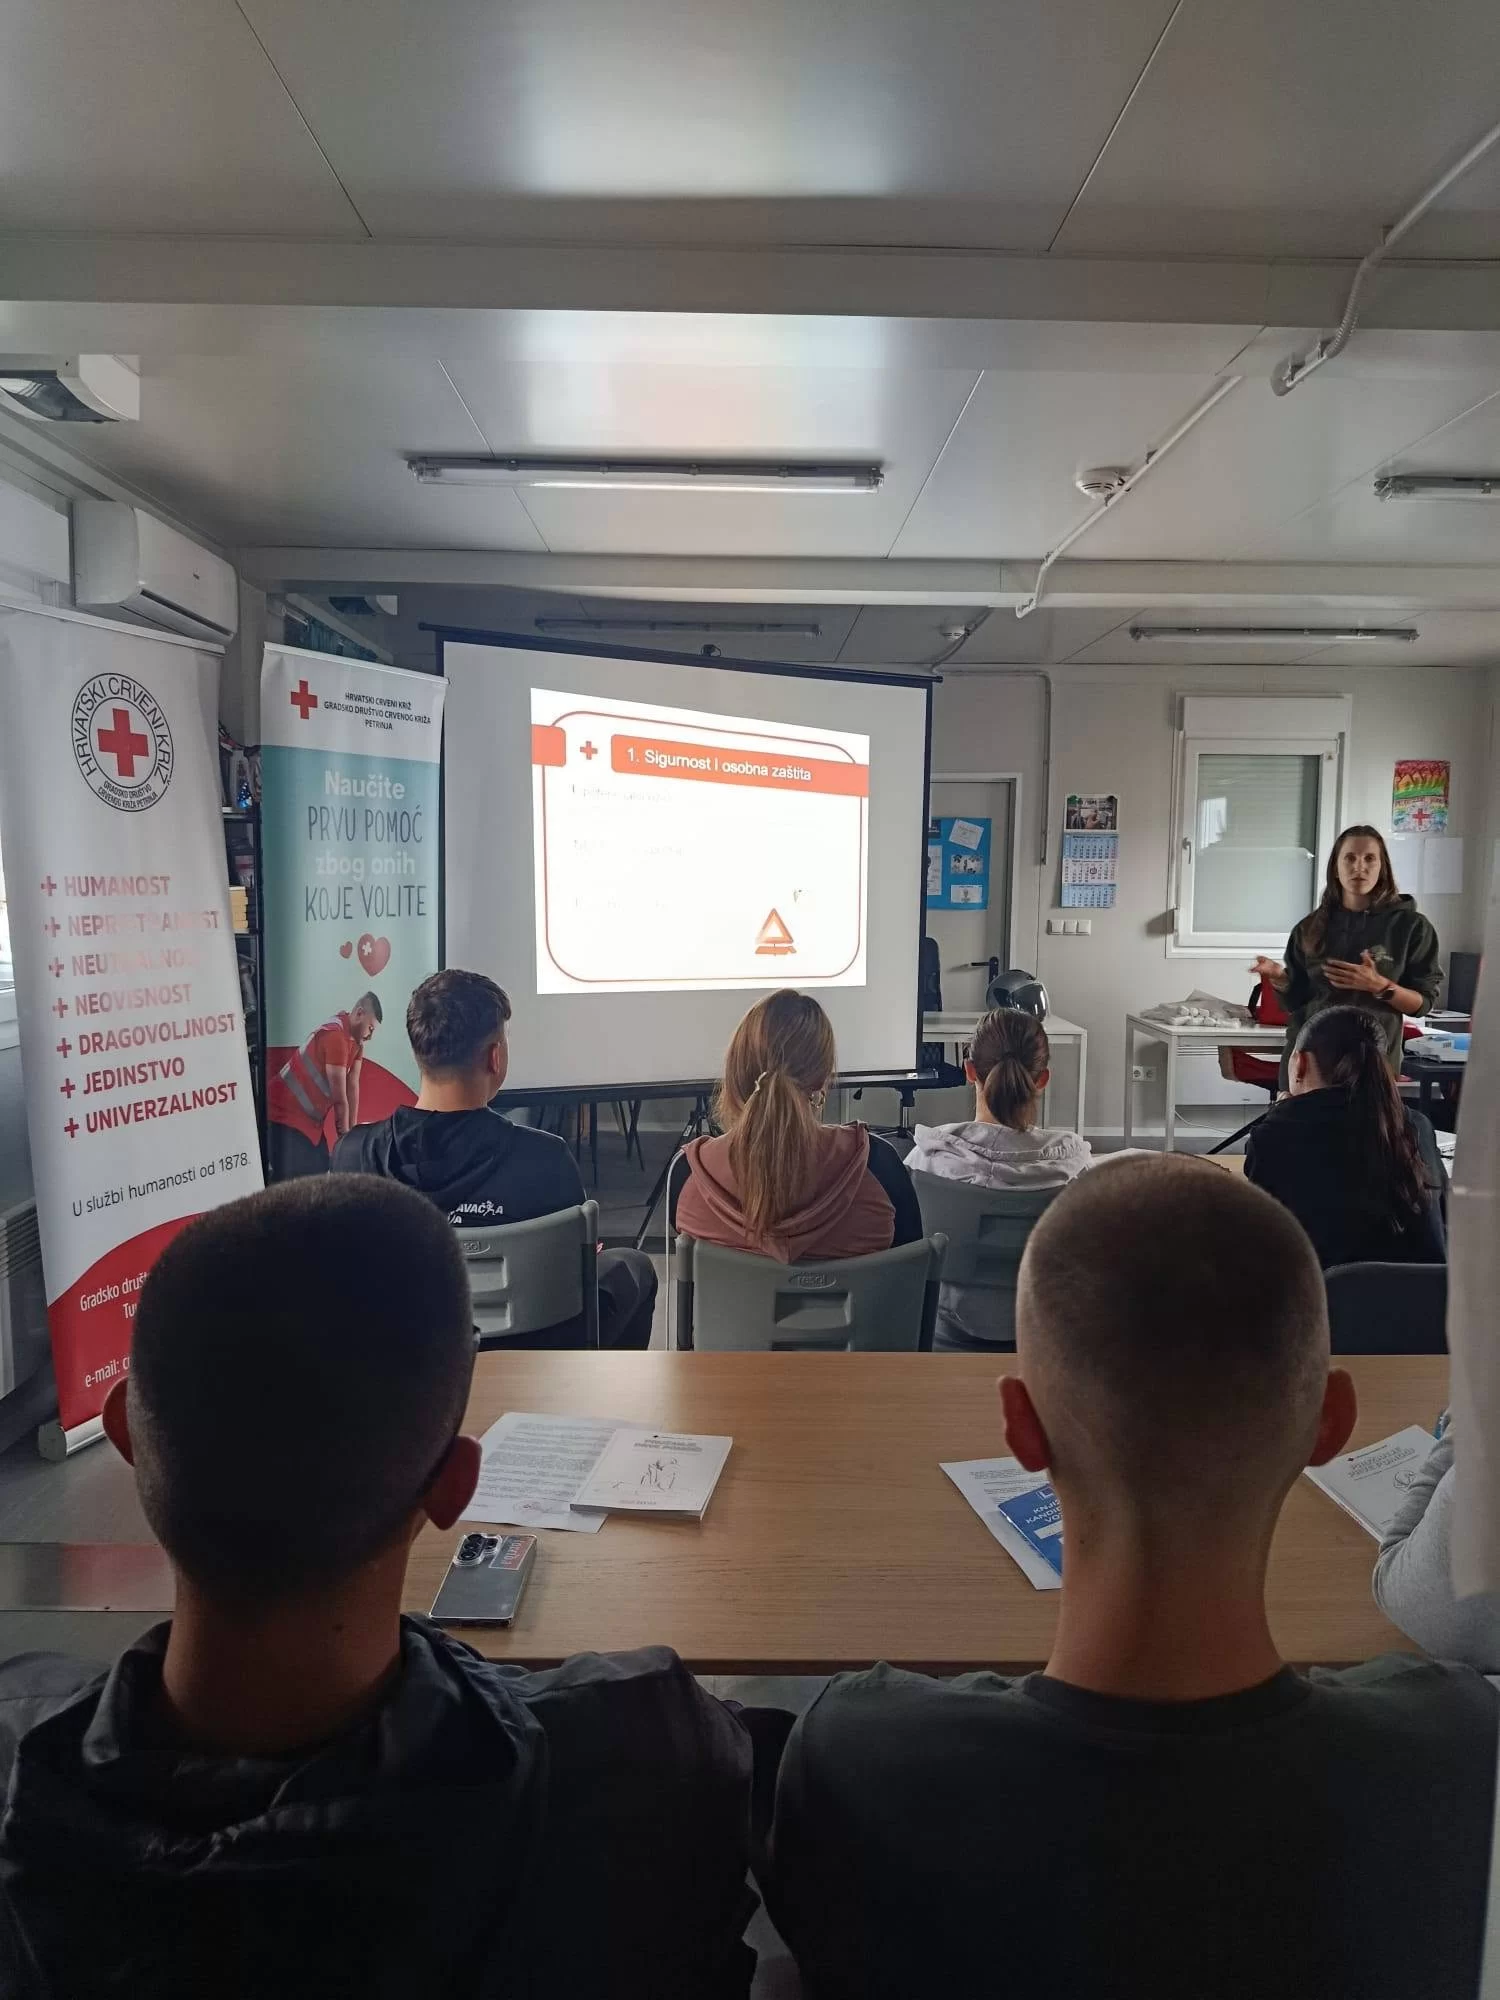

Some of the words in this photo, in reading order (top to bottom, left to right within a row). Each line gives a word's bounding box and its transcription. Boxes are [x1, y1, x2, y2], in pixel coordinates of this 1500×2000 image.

[324, 701, 354, 713] GRADSKO
[355, 705, 384, 717] DRUŠTVO
[385, 710, 414, 722] CRVENOG
[414, 714, 431, 724] KRIŽA
[345, 692, 375, 704] HRVATSKI
[376, 697, 398, 708] CRVENI
[399, 700, 412, 710] KRIŽ
[75, 680, 106, 776] HRVATSKI
[108, 677, 165, 730] CRVENI
[154, 734, 171, 785] KRIŽ
[365, 719, 393, 730] PETRINJA
[627, 747, 640, 762] 1.
[722, 761, 768, 776] osobna
[772, 764, 812, 780] zaštita
[324, 769, 406, 800] Naučite
[308, 806, 356, 842] PRVU
[365, 804, 423, 844] POMOĆ
[316, 849, 364, 882] zbog
[372, 851, 416, 875] onih
[64, 876, 171, 896] HUMANOST
[305, 885, 354, 922] KOJE
[360, 884, 427, 918] VOLITE
[75, 984, 192, 1016] NEOVISNOST
[78, 1013, 236, 1056] DRAGOVOLJNOST
[83, 1056, 186, 1095] JEDINSTVO
[86, 1082, 238, 1133] UNIVERZALNOST
[72, 1202, 82, 1217] U
[87, 1187, 124, 1213] službi
[128, 1168, 196, 1200] humanosti
[200, 1161, 216, 1179] od
[80, 1285, 120, 1312] Gradsko
[86, 1359, 120, 1388] e-mail:
